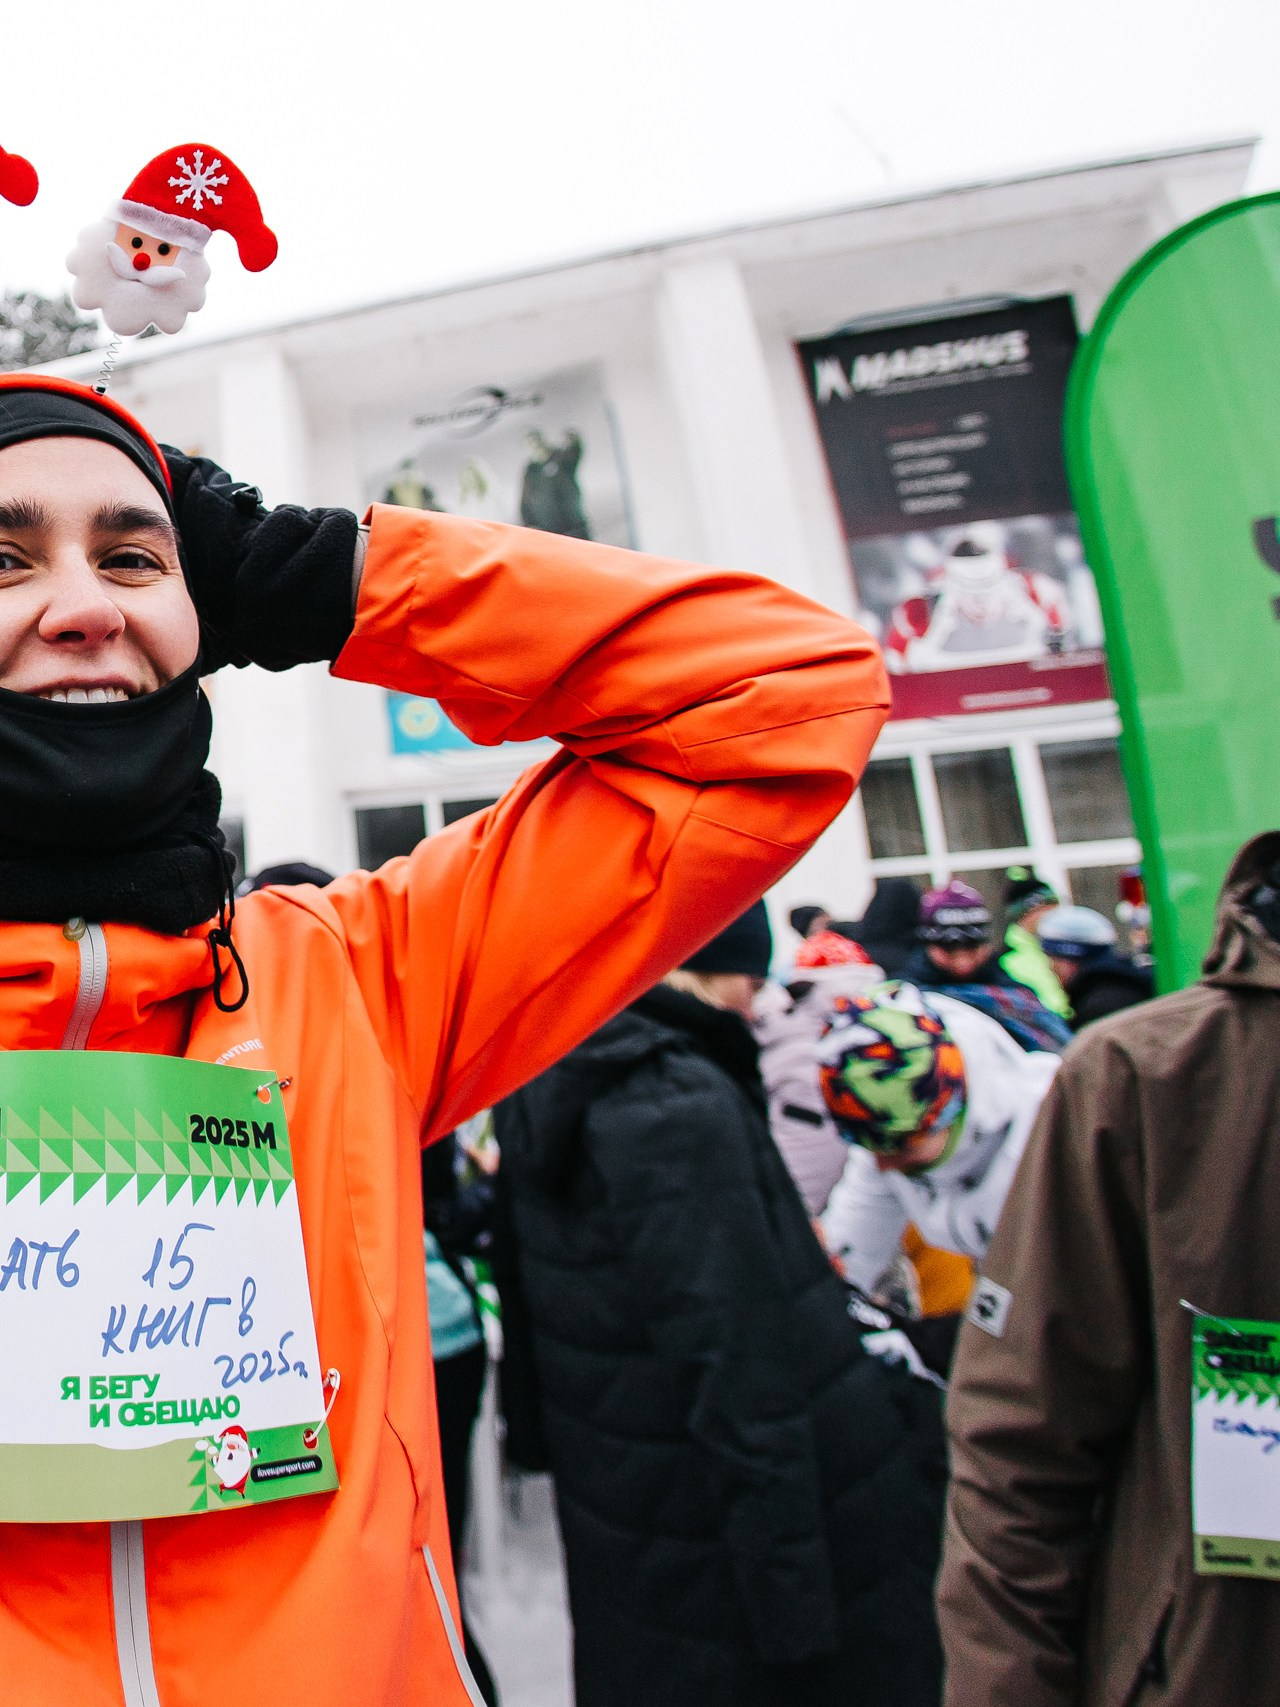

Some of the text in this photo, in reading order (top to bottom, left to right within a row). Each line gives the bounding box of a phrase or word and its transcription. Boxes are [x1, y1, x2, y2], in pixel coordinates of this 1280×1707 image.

[214, 1038, 265, 1065] ENTURE
[142, 1222, 215, 1290] 15
[60, 1373, 161, 1400] Я БЕГУ
[89, 1395, 240, 1428] И ОБЕЩАЮ
